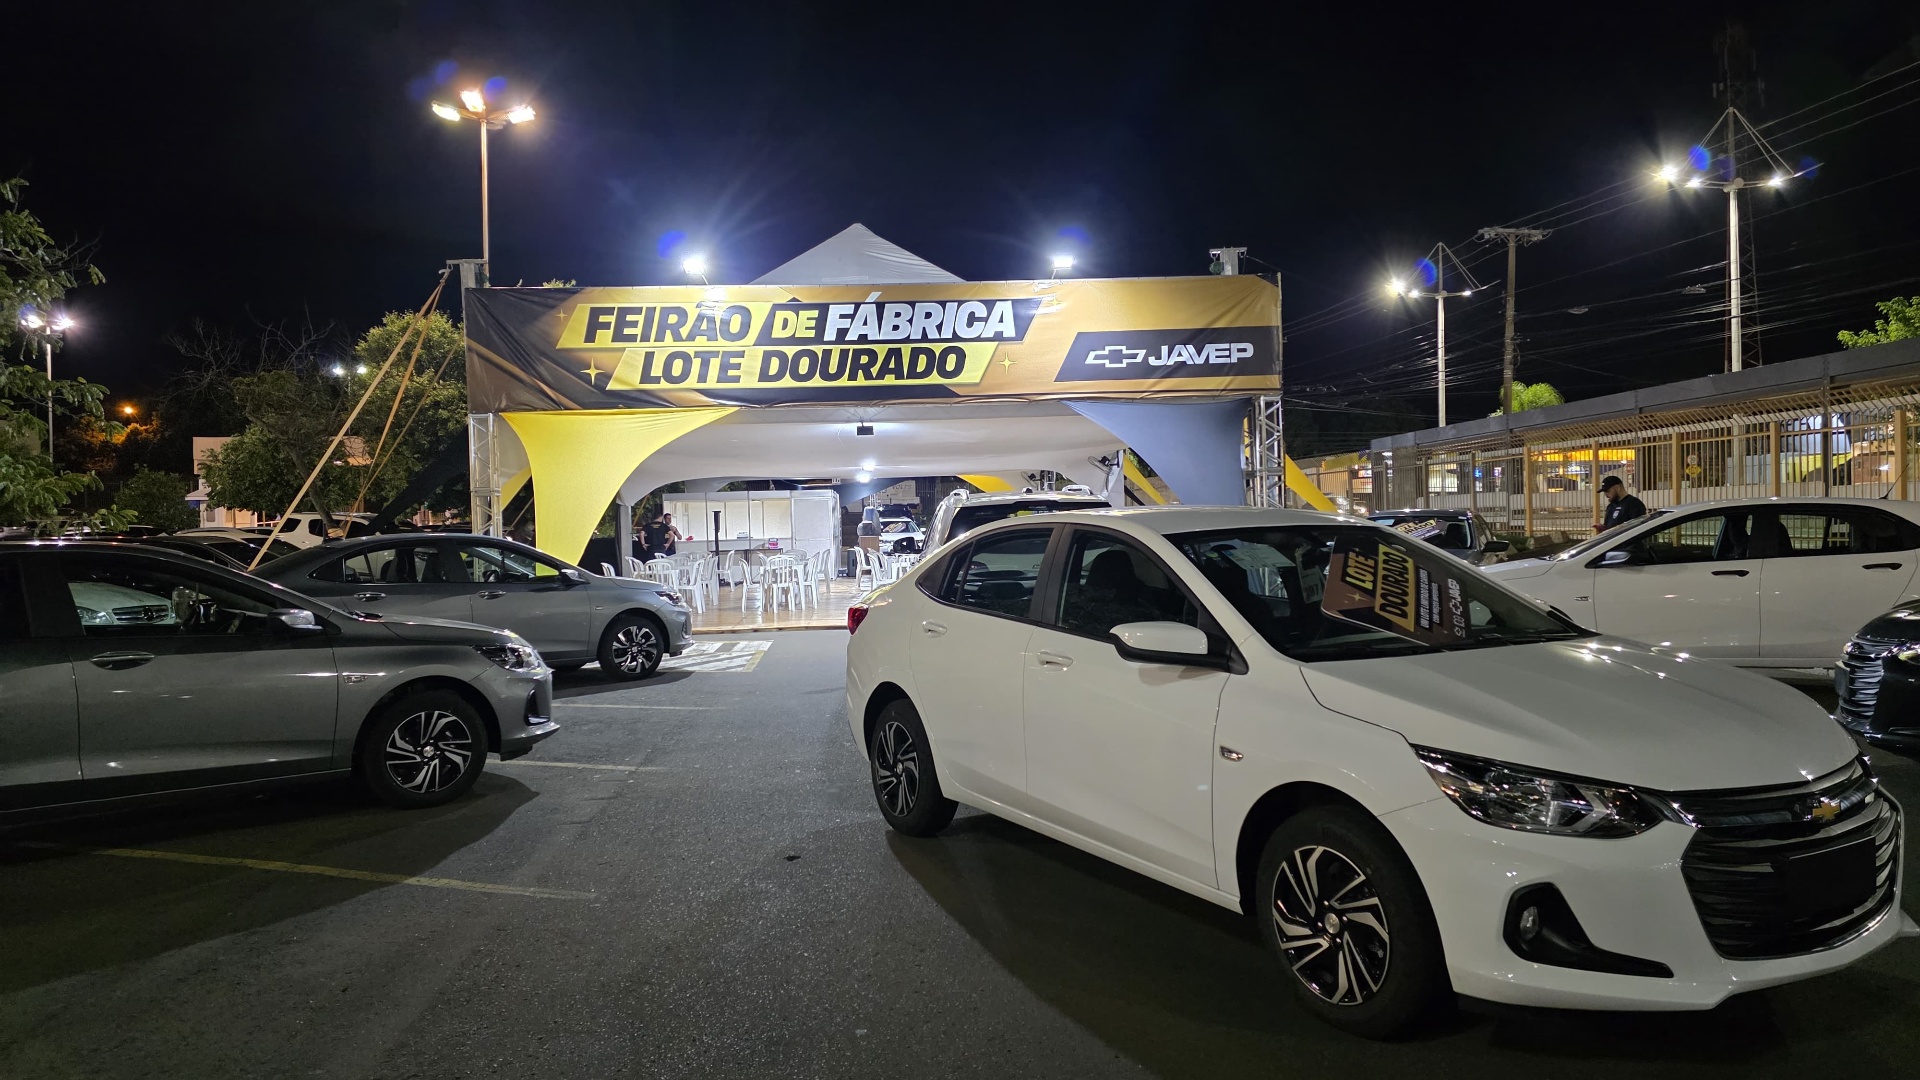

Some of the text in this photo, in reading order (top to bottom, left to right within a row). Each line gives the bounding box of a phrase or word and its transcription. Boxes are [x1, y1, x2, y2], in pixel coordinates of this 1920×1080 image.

[583, 292, 1016, 344] FEIRÃO DE FÁBRICA
[639, 346, 966, 384] LOTE DOURADO
[1148, 343, 1254, 365] JAVEP
[1345, 552, 1375, 590] LOTE
[1379, 551, 1409, 619] DOURADO
[1447, 578, 1461, 602] JAVEP
